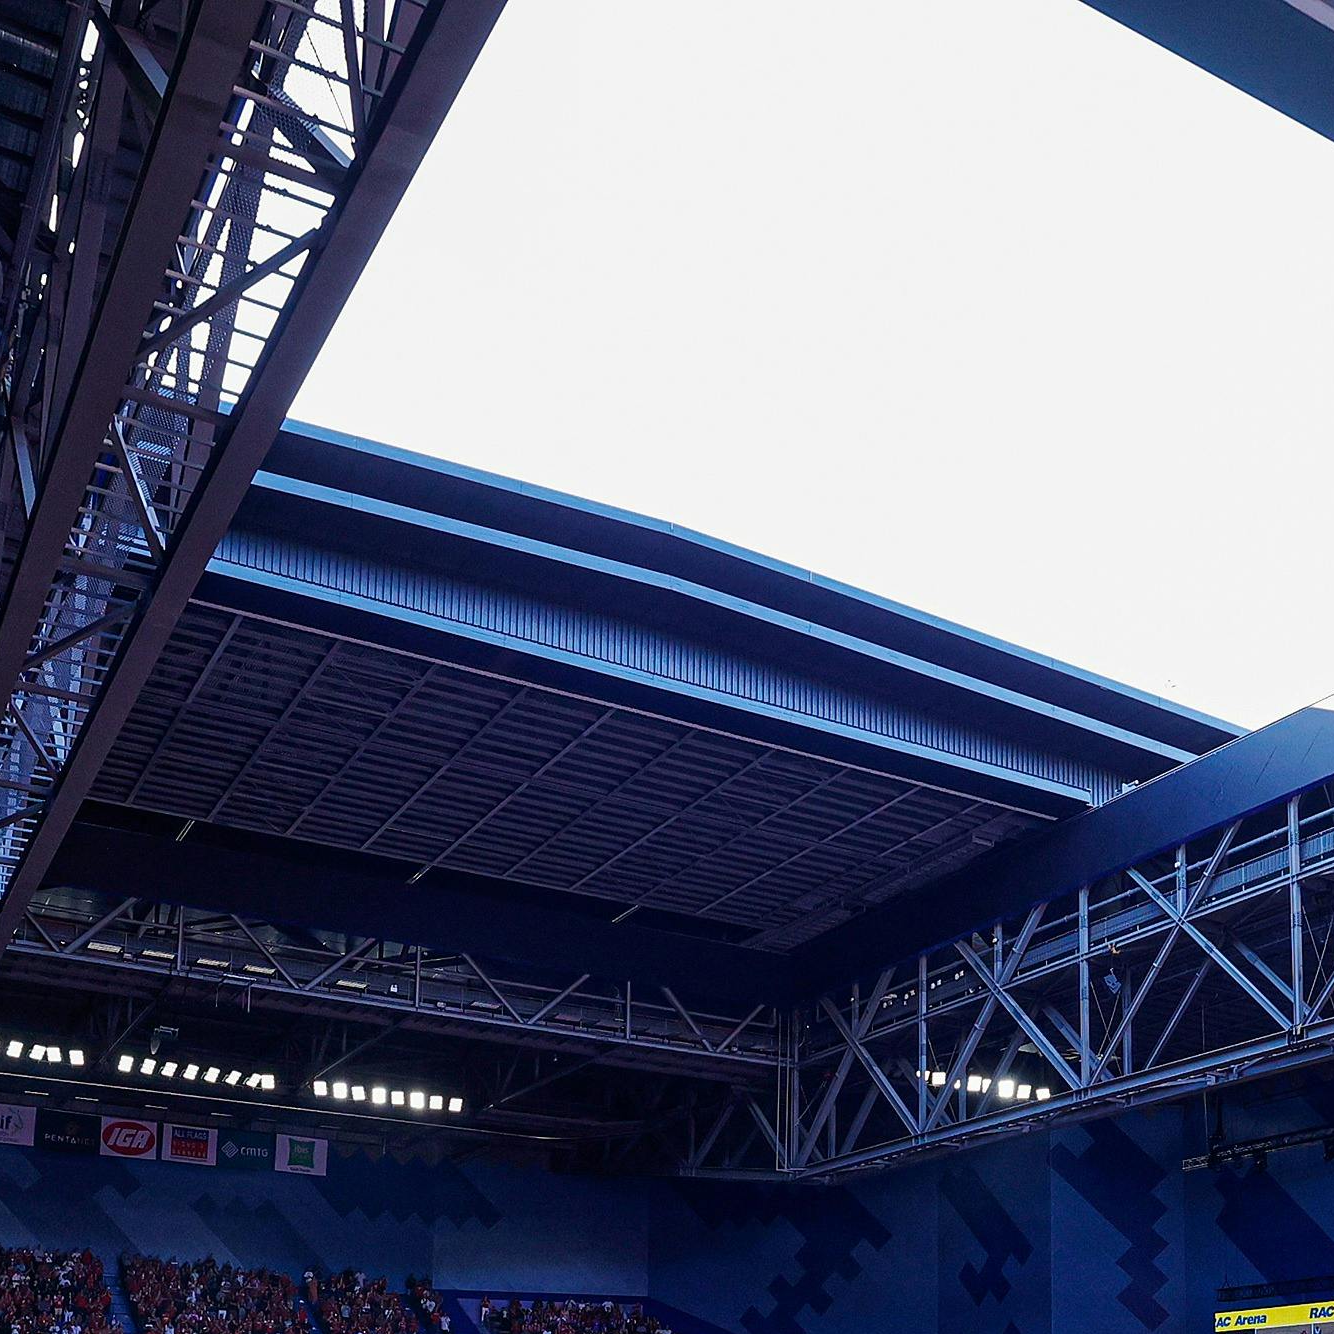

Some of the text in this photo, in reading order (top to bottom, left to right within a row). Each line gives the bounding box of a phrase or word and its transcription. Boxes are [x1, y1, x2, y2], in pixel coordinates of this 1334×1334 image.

[107, 1127, 151, 1149] IGA
[1215, 1314, 1267, 1328] AC Arena
